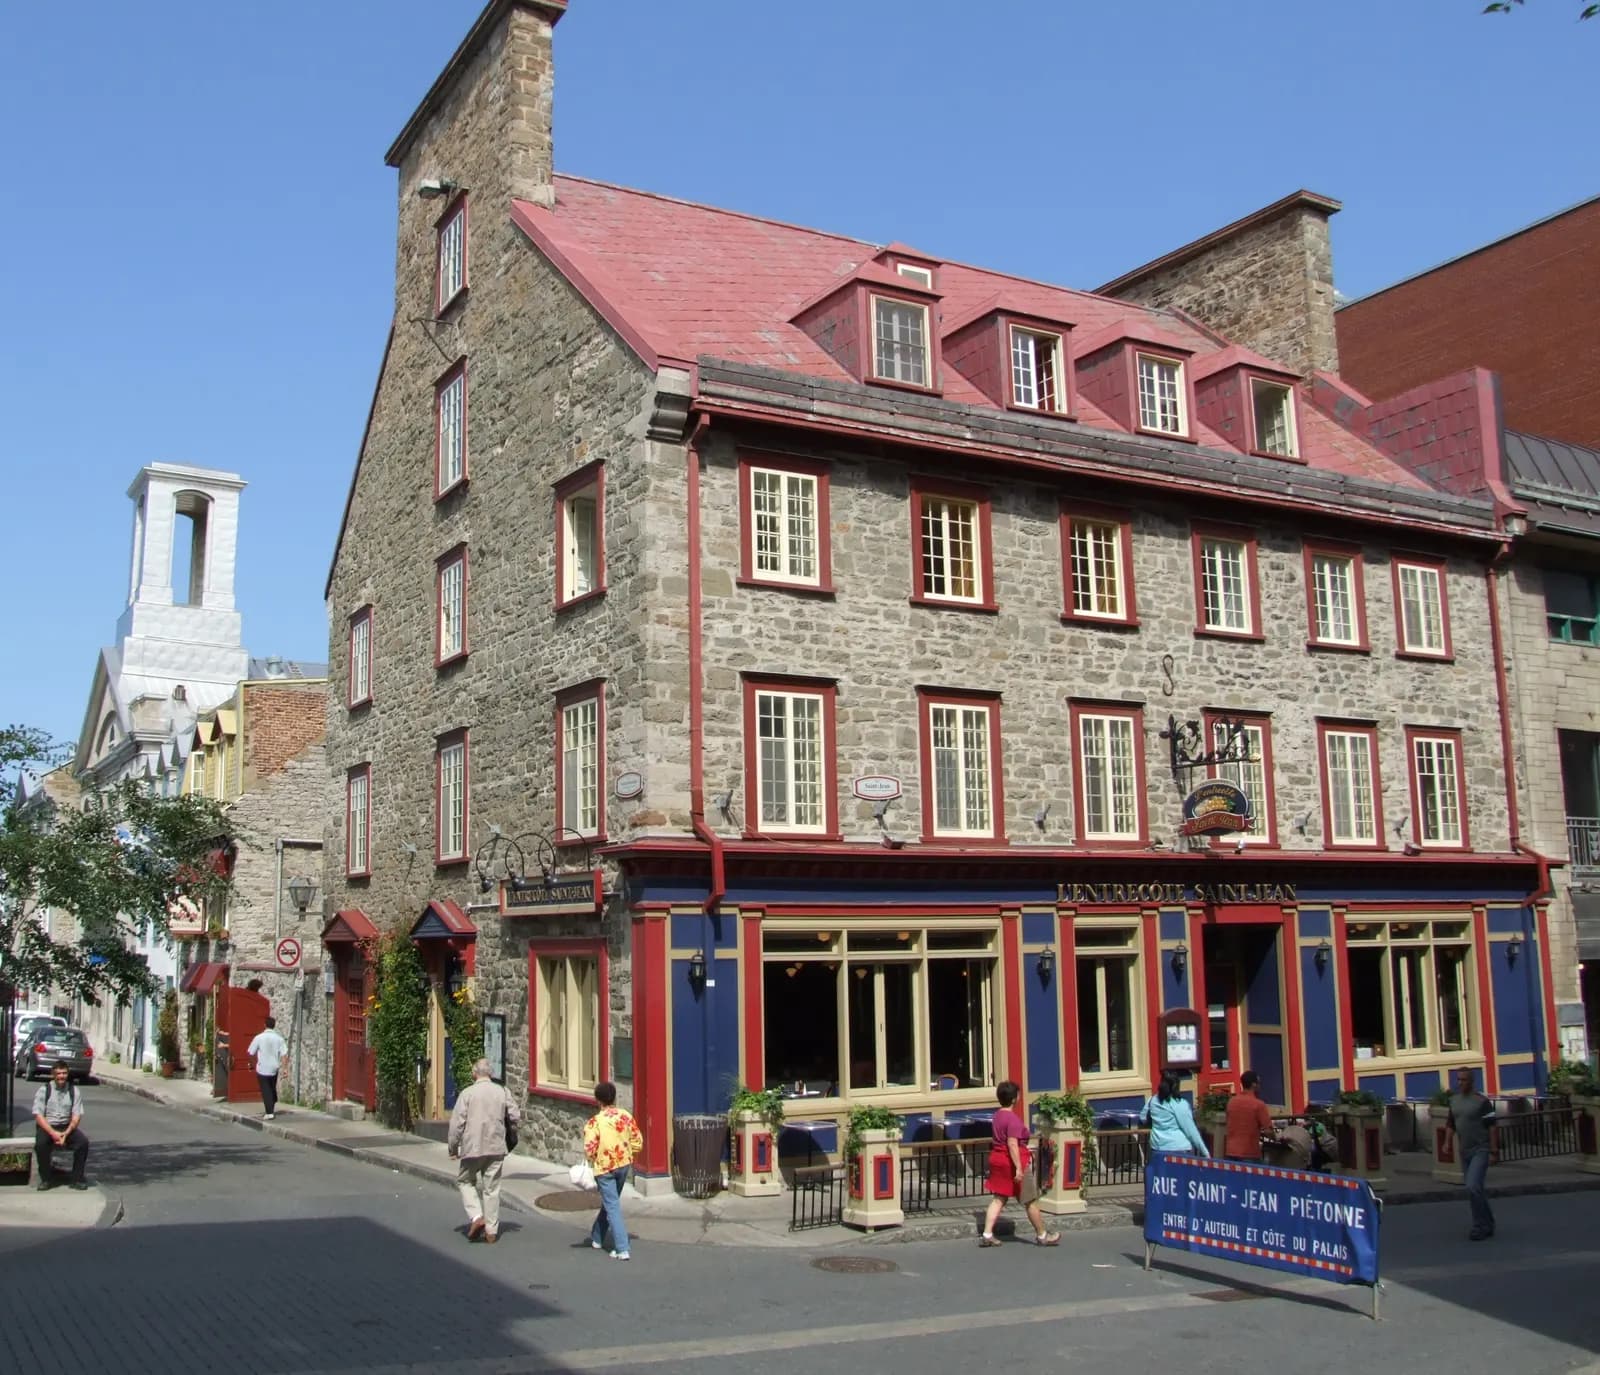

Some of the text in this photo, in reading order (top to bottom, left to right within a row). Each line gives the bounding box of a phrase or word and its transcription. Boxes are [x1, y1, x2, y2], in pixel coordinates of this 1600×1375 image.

[1057, 880, 1297, 902] L'ENTRECÔTE SAINT-JEAN
[1152, 1176, 1178, 1197] RUE
[1290, 1194, 1365, 1230] PIÉTONNE
[1192, 1217, 1240, 1239] D'AUTEUIL
[1246, 1227, 1258, 1242] ET
[1262, 1228, 1286, 1248] CÔTE
[1293, 1236, 1306, 1252] DU
[1312, 1239, 1348, 1261] PALAIS
